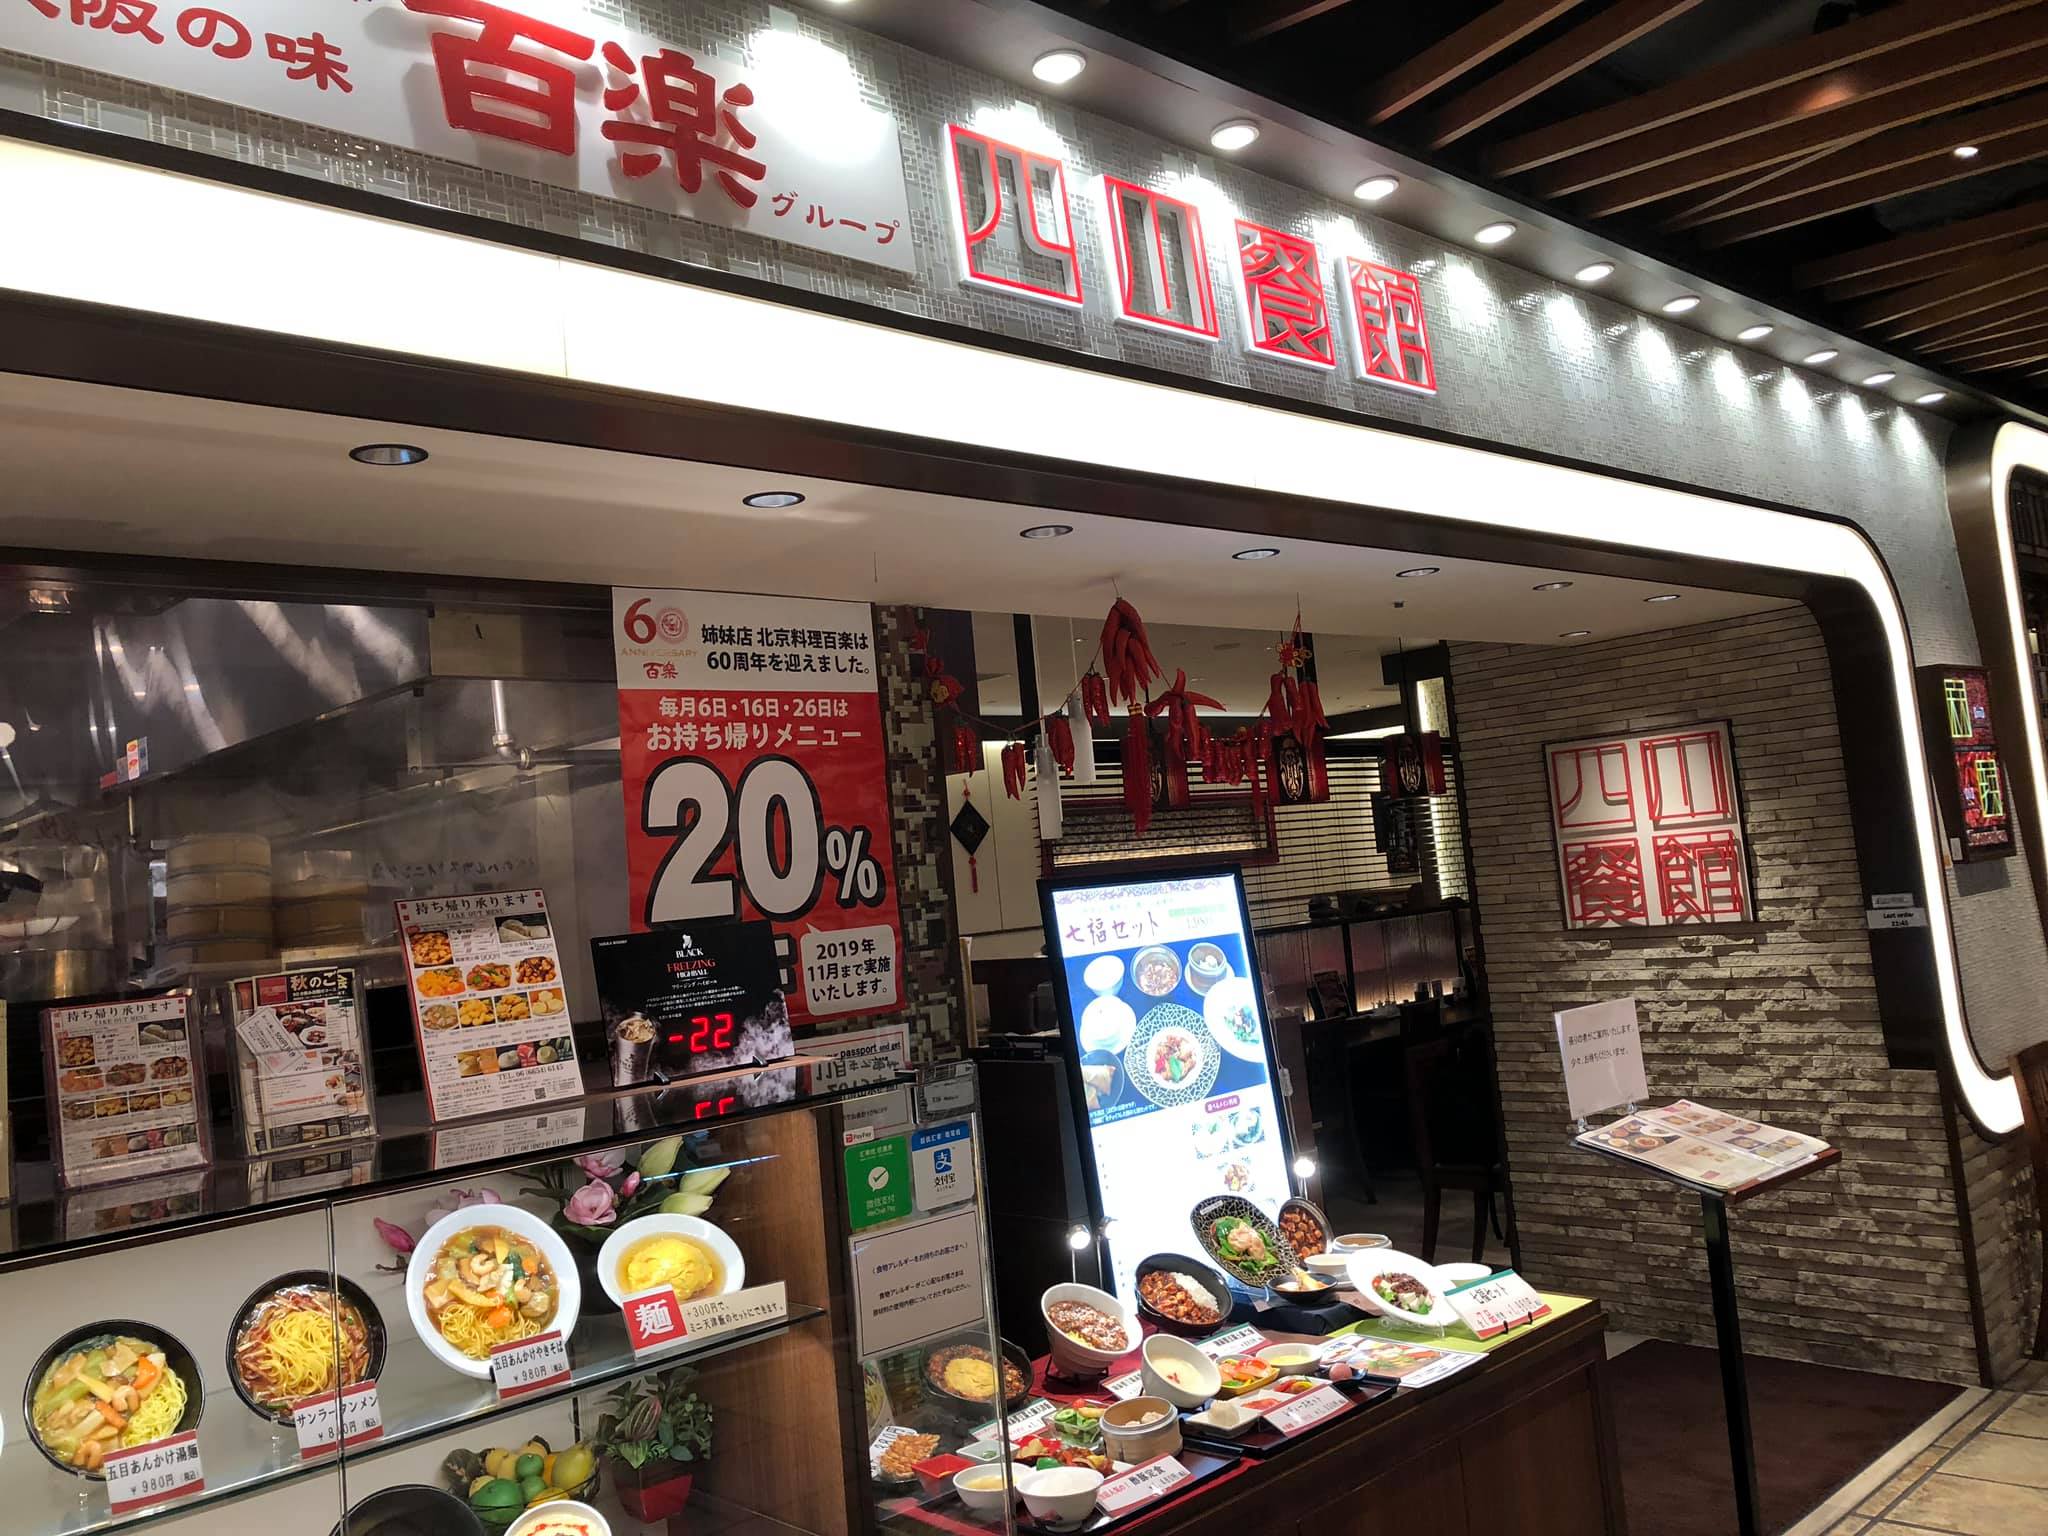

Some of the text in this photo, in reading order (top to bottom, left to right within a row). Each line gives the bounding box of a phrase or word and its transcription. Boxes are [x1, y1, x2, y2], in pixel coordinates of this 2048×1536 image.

[26, 0, 354, 93] 阪の味
[401, 0, 766, 211] 百楽
[770, 189, 901, 245] グループ
[701, 623, 869, 650] 姉妹店 北京料理百楽は
[706, 650, 870, 674] 60周年を迎えました。
[658, 695, 849, 718] 毎月6日・16日・26日は
[646, 721, 862, 752] お持ち帰りメニュー
[641, 754, 886, 924] 20%
[1064, 911, 1160, 946] 七福セット
[675, 947, 704, 959] BLACK
[816, 938, 876, 961] 2019年
[807, 955, 892, 982] 11月まで実施
[811, 977, 890, 1003] いたします。
[669, 1013, 735, 1053] -22
[840, 1043, 877, 1060] passport
[634, 1299, 675, 1340] 麺
[494, 1340, 564, 1371] 五目あんかけやきそば
[107, 1443, 198, 1481] 五目あんかけ湯麺
